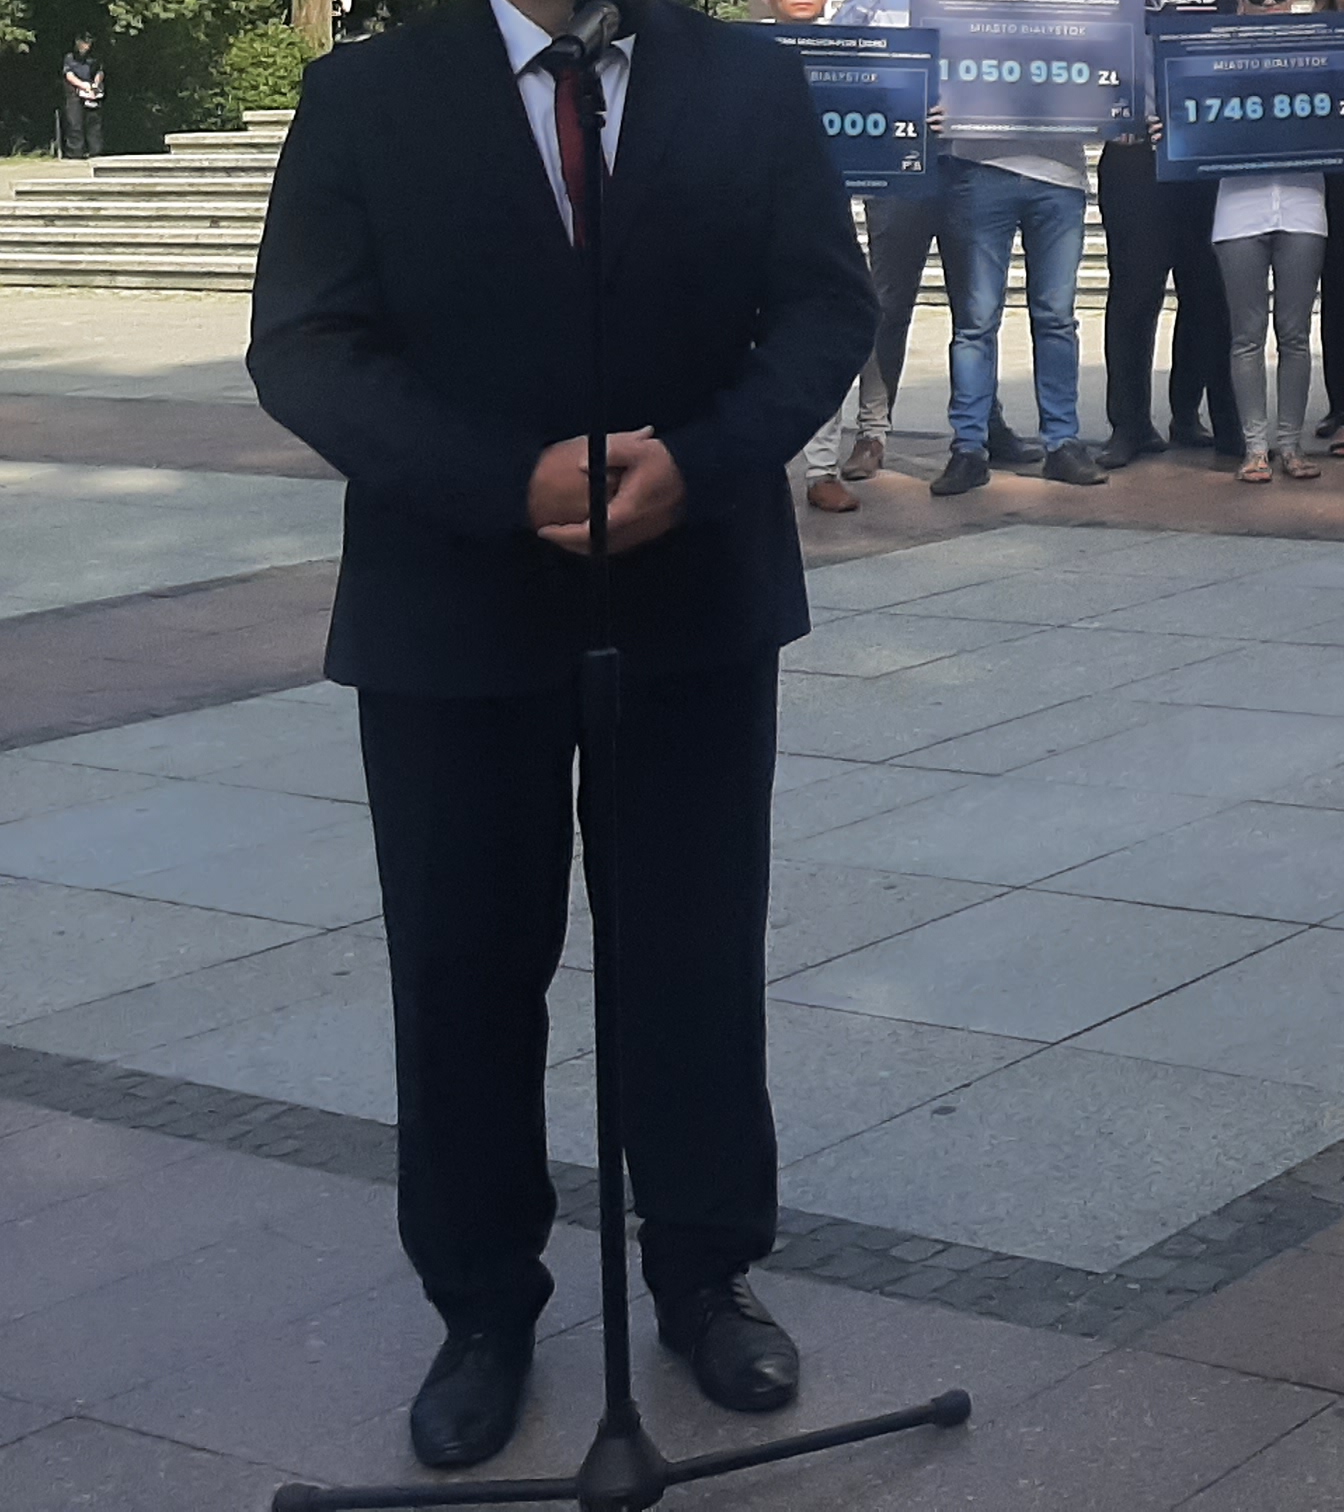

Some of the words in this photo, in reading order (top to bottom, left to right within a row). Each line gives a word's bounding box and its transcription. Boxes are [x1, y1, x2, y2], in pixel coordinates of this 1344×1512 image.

[938, 58, 949, 81] 1
[958, 58, 1022, 83] 050
[1029, 60, 1091, 85] 950
[1183, 98, 1199, 124] 1
[1204, 95, 1265, 123] 746
[1272, 92, 1333, 119] 869
[821, 111, 888, 137] 000
